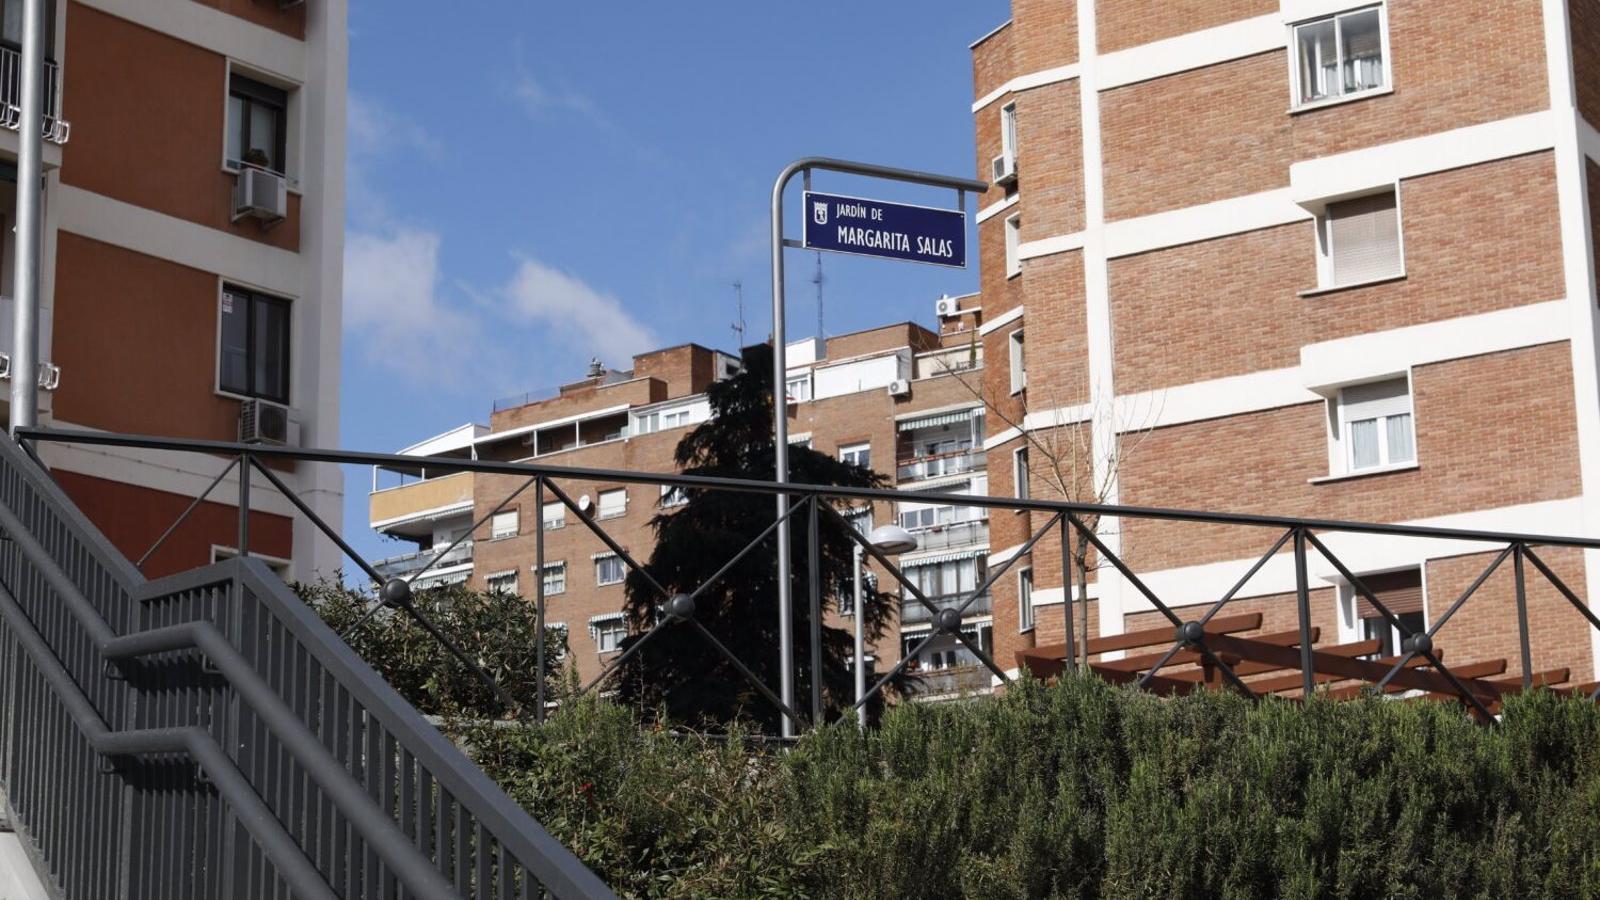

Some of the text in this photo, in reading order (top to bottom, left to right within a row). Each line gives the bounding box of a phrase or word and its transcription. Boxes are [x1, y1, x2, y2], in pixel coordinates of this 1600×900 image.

[836, 203, 883, 221] JARDÍN DE
[838, 225, 953, 258] MARGARITA SALAS
